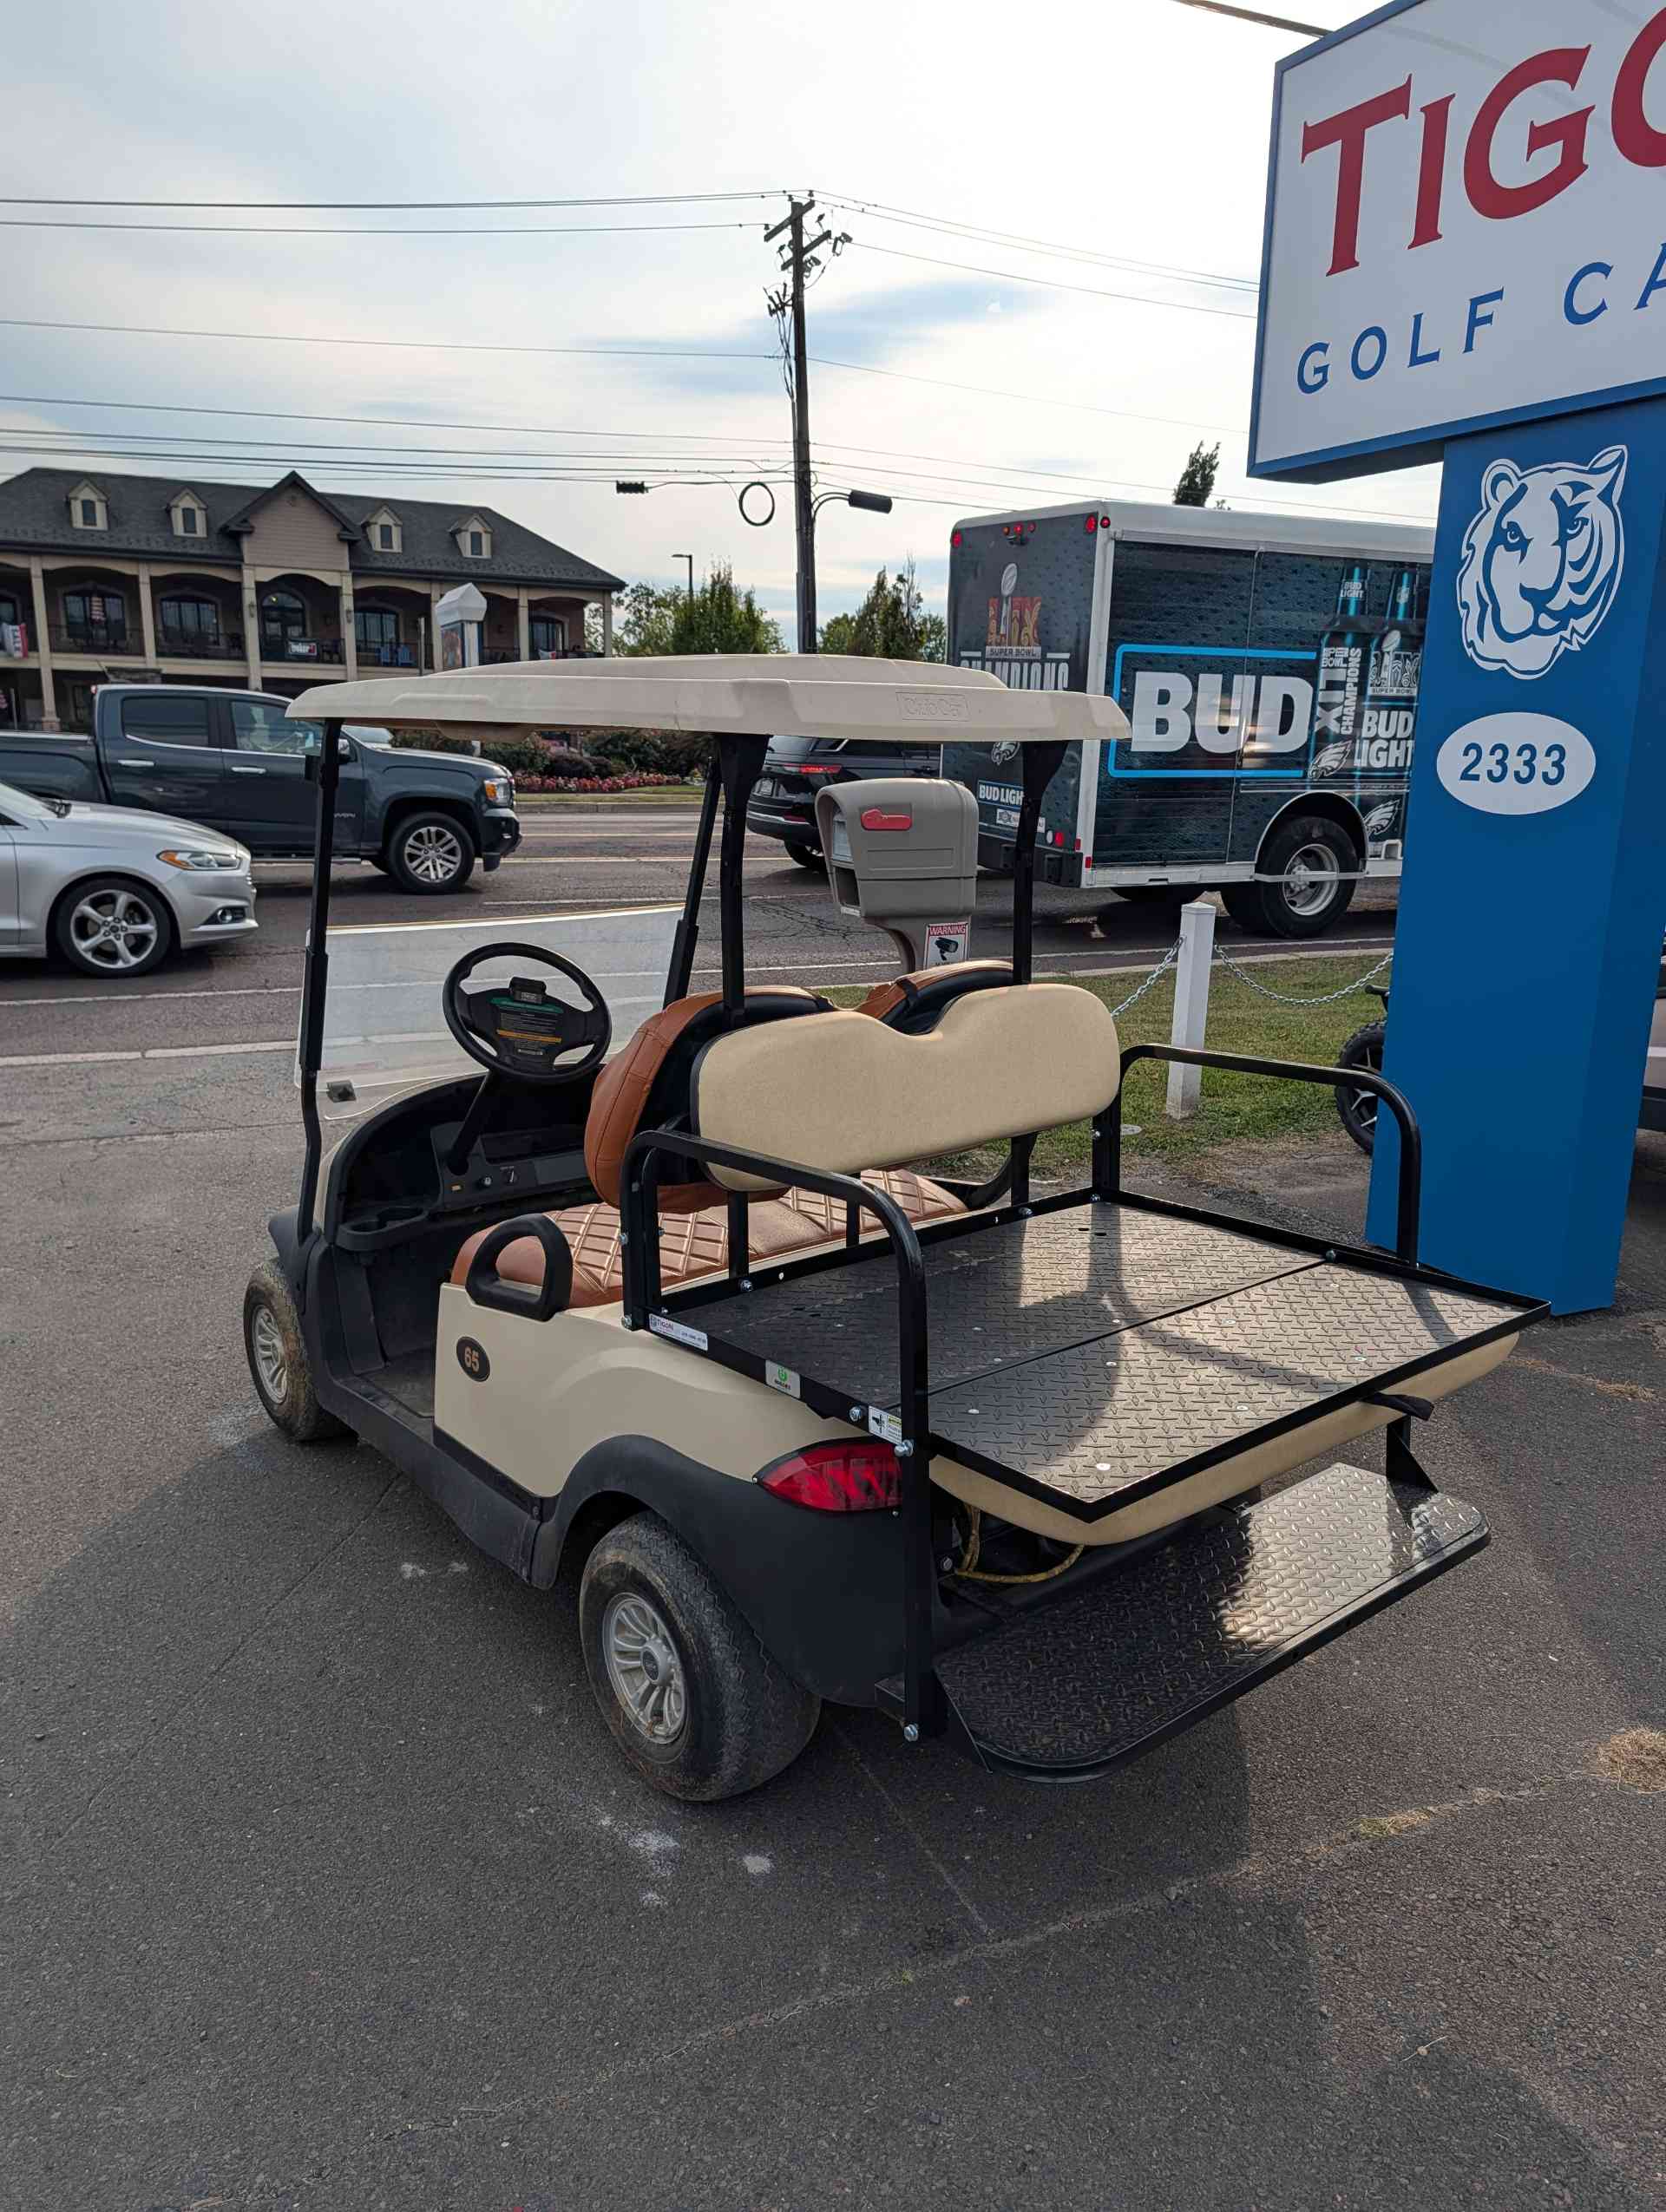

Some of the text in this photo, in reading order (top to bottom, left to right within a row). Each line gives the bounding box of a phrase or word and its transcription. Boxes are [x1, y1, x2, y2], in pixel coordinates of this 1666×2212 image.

[1296, 287, 1505, 395] GOLF
[989, 647, 1037, 657] SUPER BOWL
[1322, 658, 1348, 667] BOWL
[1341, 648, 1361, 735] CHAMPIONS
[1131, 671, 1313, 754] BUD
[1361, 710, 1414, 738] BUD
[1354, 739, 1414, 768] LIGHT
[1459, 743, 1566, 786] 2333
[979, 784, 1024, 805] BUD LIGH
[929, 925, 966, 935] WARNING
[464, 1346, 479, 1372] 65
